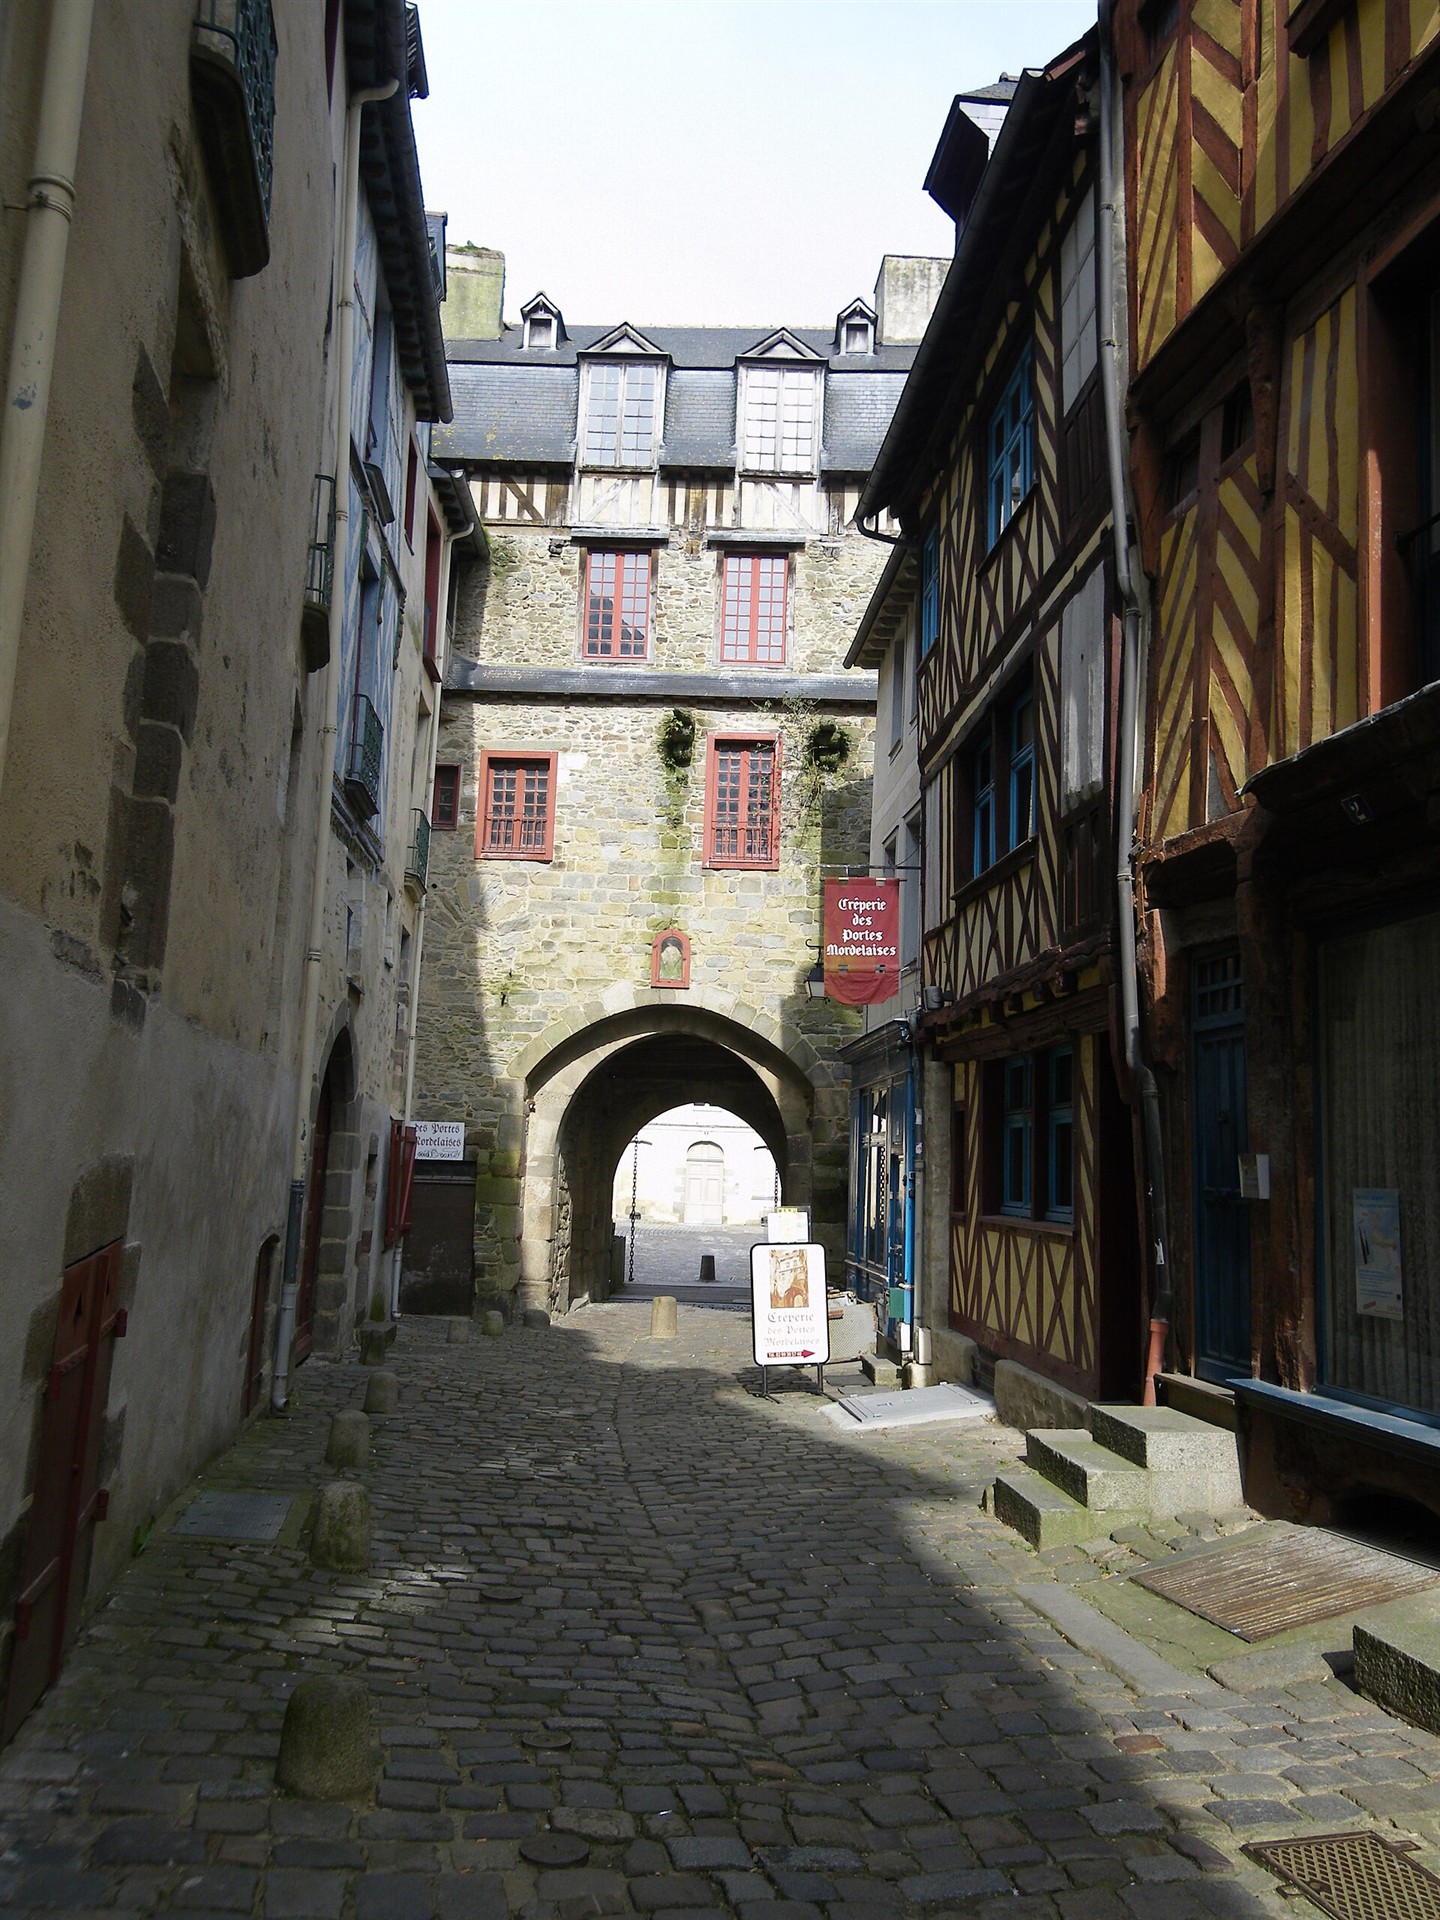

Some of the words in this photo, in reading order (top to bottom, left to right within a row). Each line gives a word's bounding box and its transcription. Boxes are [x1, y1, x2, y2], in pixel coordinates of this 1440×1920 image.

[838, 898, 887, 914] Crêperie
[852, 913, 873, 926] des
[842, 929, 883, 943] Portes
[826, 944, 897, 956] Mordelaises
[431, 1123, 460, 1134] Portes
[786, 1325, 815, 1335] Portes
[764, 1337, 820, 1347] Mordelaises
